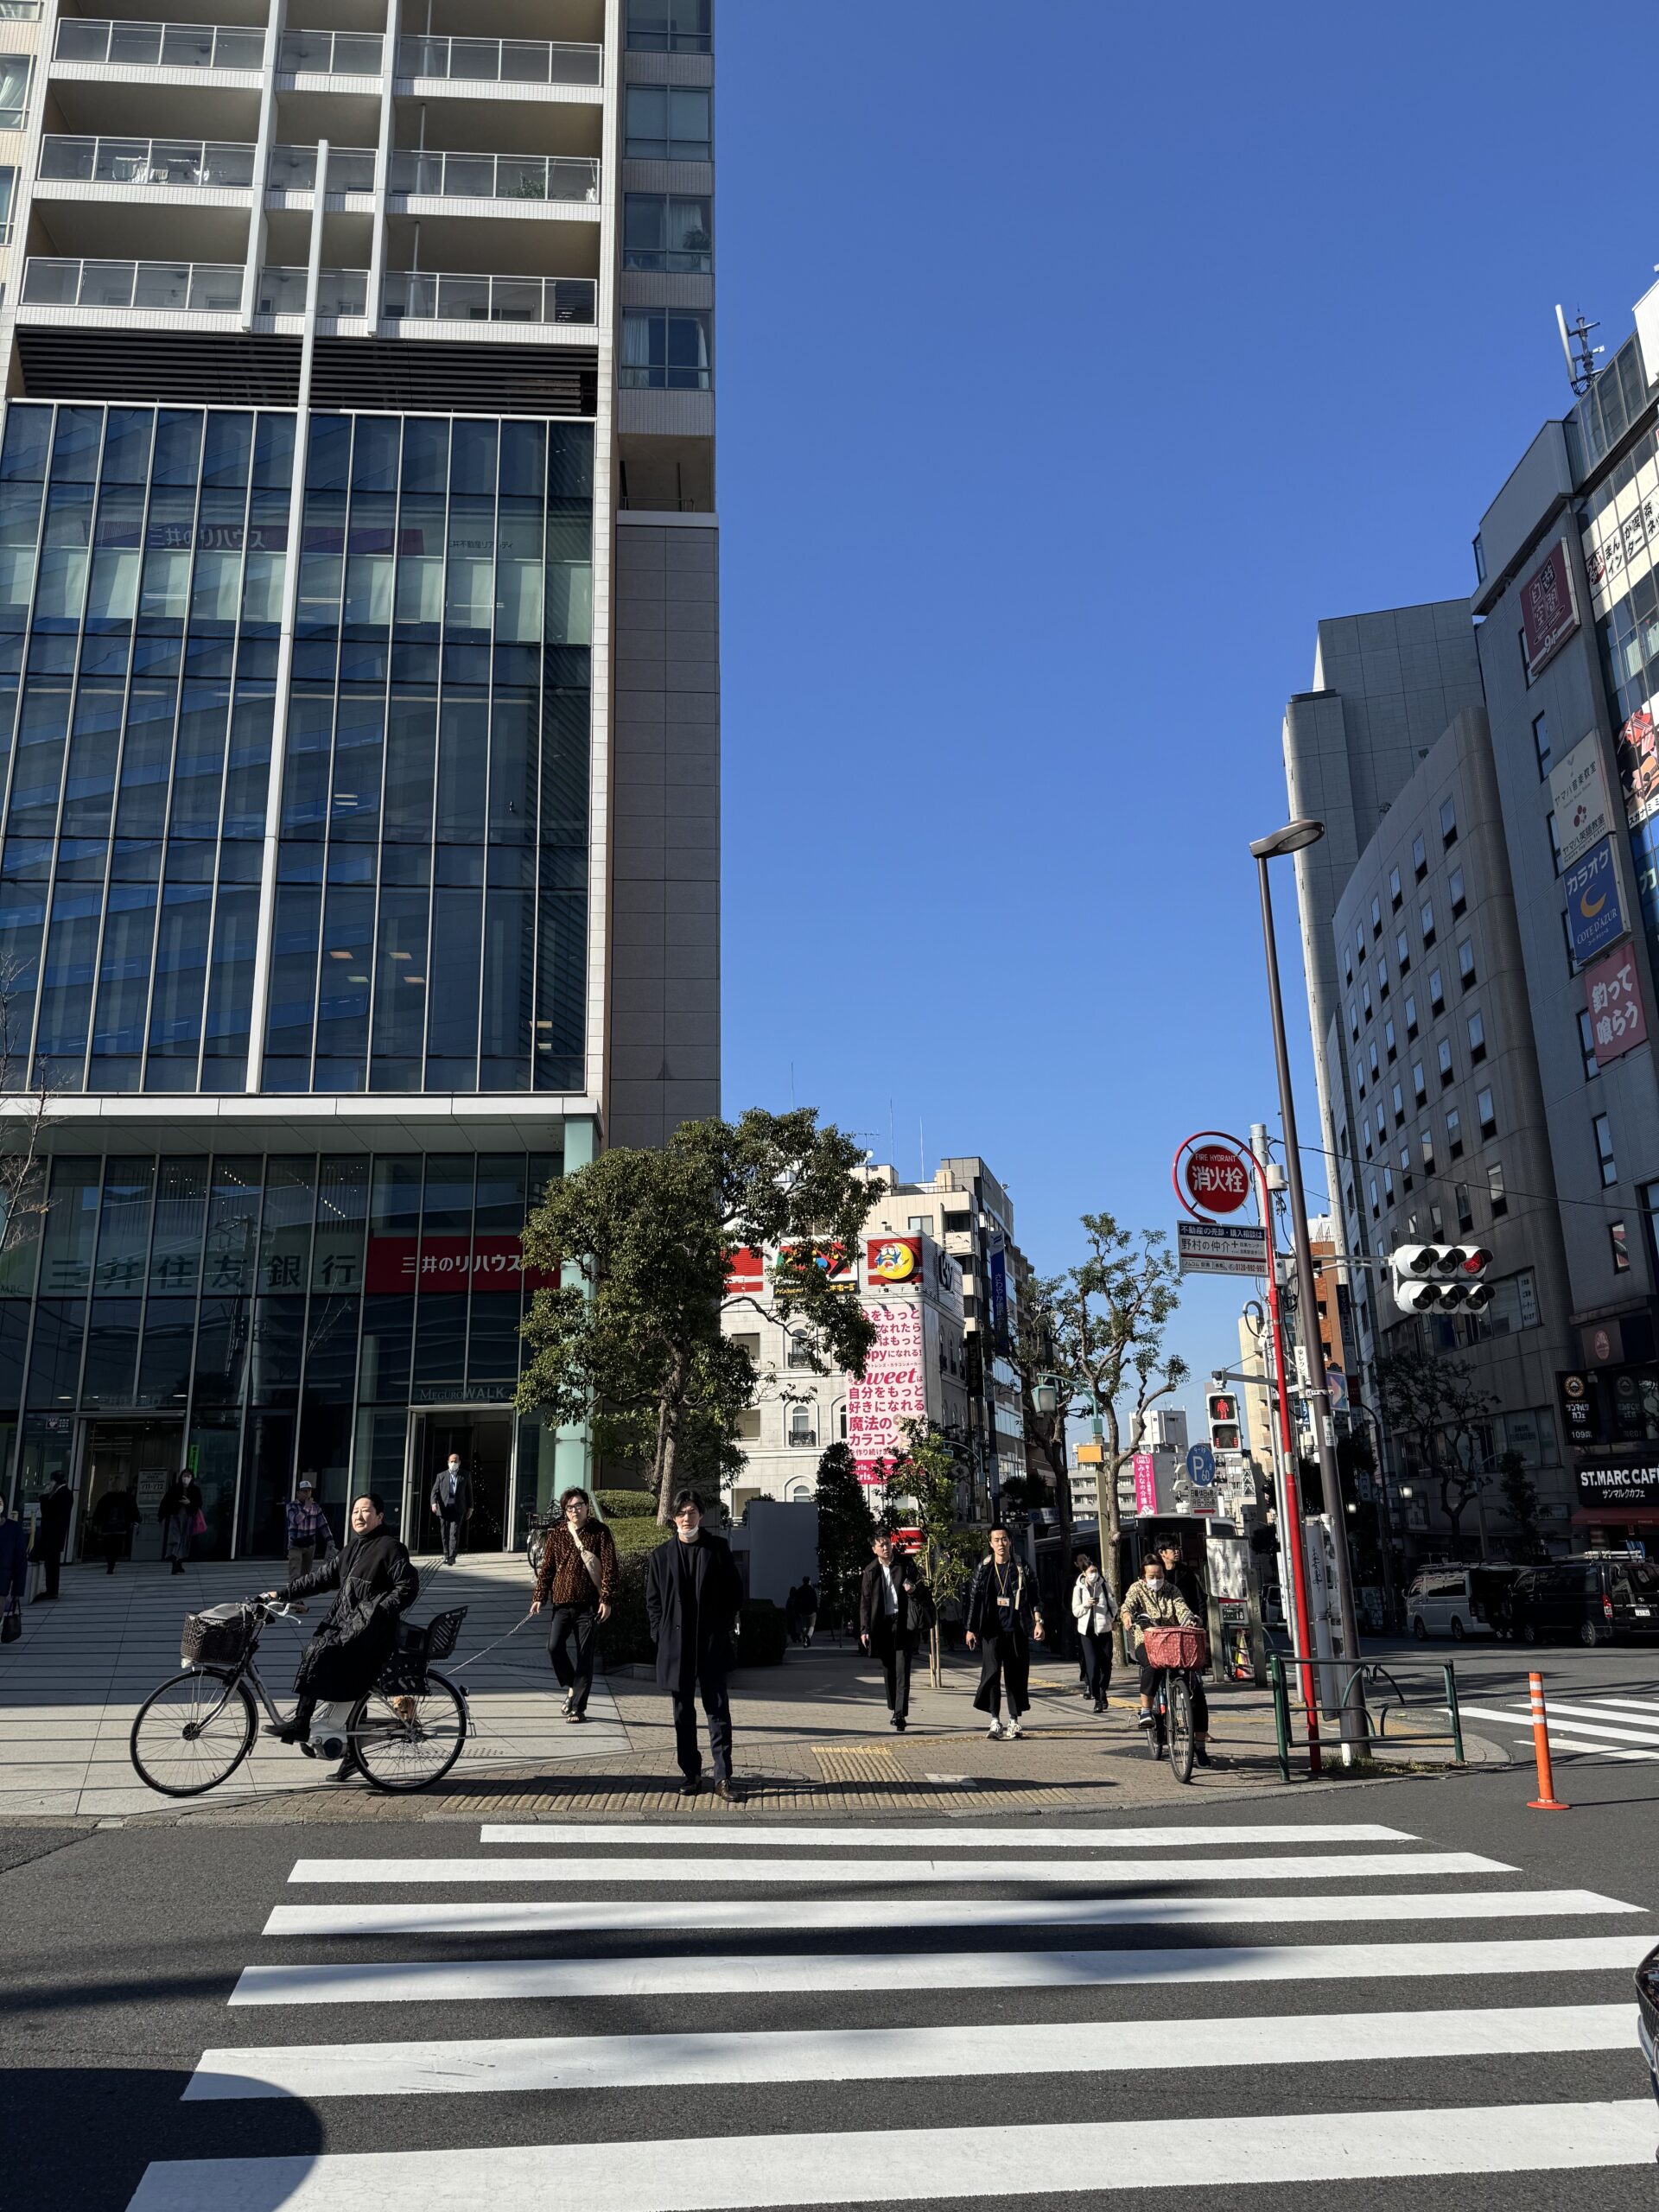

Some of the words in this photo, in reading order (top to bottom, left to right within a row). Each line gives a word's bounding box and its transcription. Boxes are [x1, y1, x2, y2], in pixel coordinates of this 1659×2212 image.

[448, 539, 513, 550] 三井不動産リアティ
[1554, 760, 1597, 807] ヤマハ音楽教室
[1562, 813, 1605, 856] ヤマハ英語教室
[1567, 848, 1610, 896] カラオケ
[1592, 963, 1633, 1014] 釣って
[1210, 1154, 1236, 1163] HYDRANT
[1192, 1165, 1245, 1193] 消火栓
[1180, 1225, 1263, 1239] 不動産の売却・購入相談は
[401, 1255, 522, 1274] 三井のリハウス
[48, 1255, 356, 1291] 三井住友銀行
[861, 1309, 920, 1321] 分をもっと
[878, 1323, 921, 1334] なれたら
[880, 1335, 922, 1346] はもっと
[849, 1385, 925, 1400] 自分をもっと
[849, 1400, 925, 1414] 好きになれる
[849, 1415, 893, 1432] 魔法の
[849, 1433, 899, 1446] カラコン
[1192, 1455, 1205, 1482] P
[1201, 1470, 1211, 1482] 60
[1137, 1465, 1147, 1504] みんなの介護
[1580, 1469, 1631, 1487] ST.MARC
[1602, 1488, 1646, 1500] サンマルクカフェ
